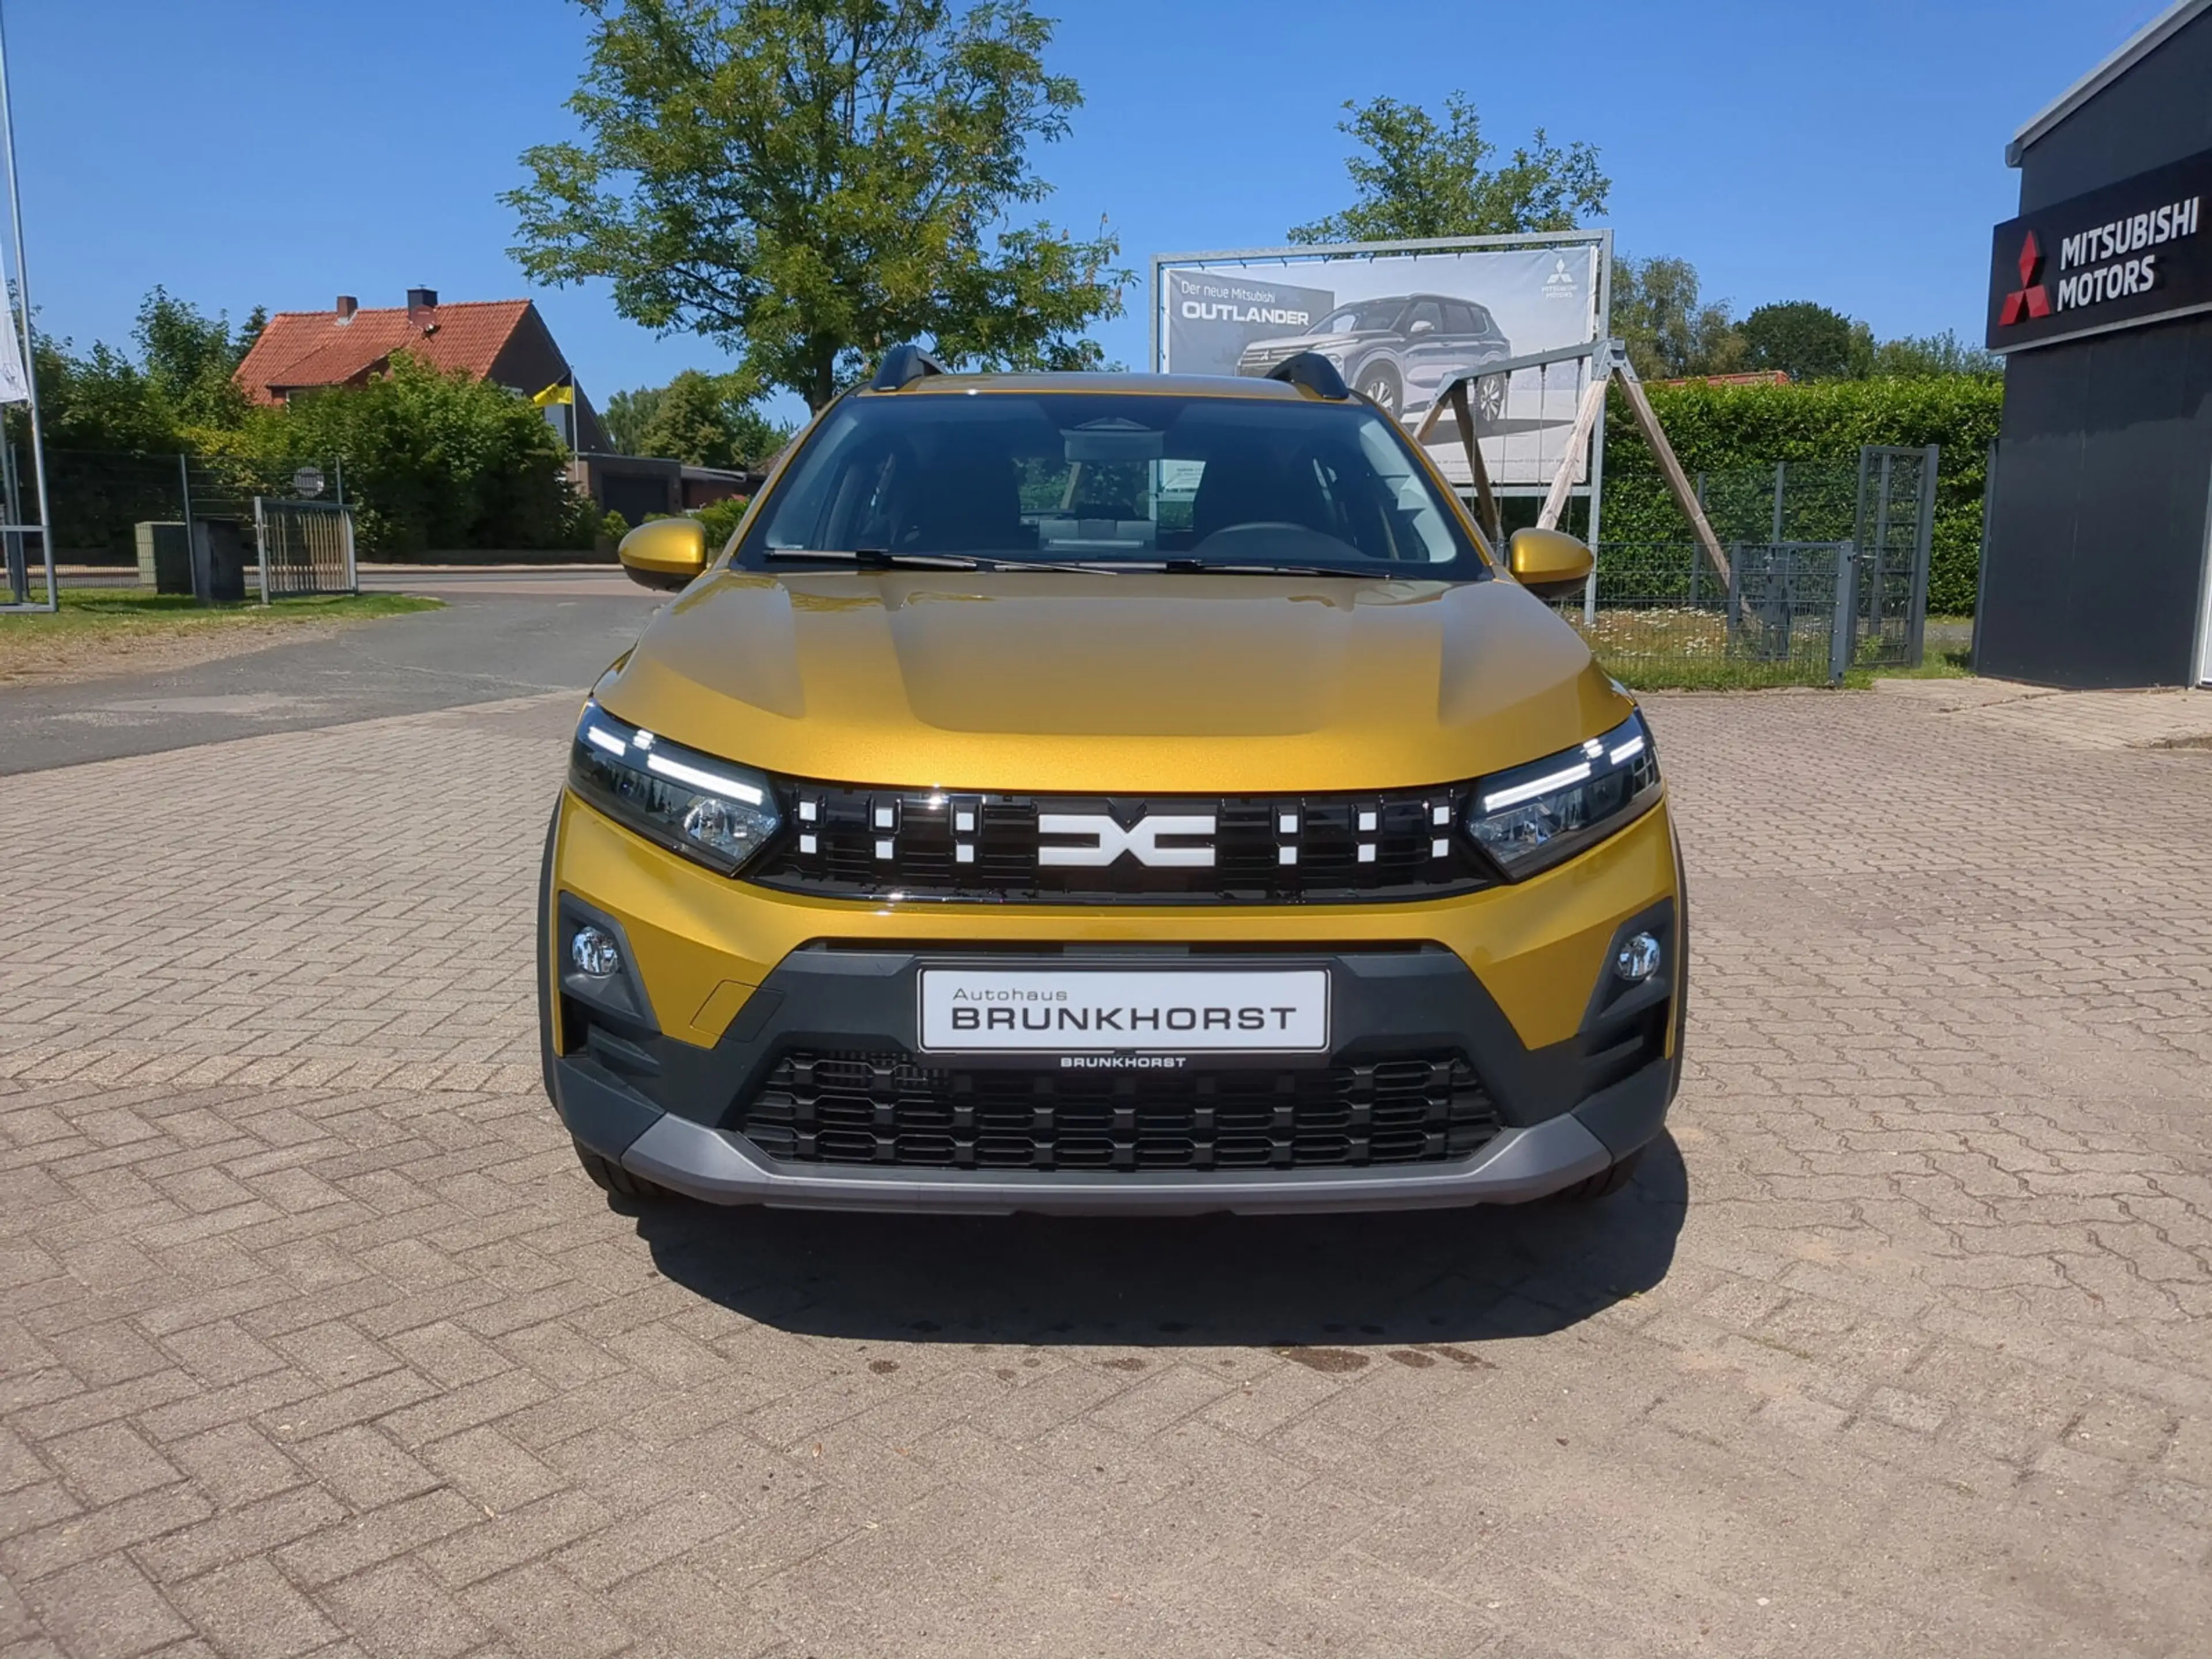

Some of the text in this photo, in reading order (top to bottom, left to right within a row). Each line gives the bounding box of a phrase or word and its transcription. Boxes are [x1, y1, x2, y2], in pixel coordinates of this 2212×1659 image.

[2060, 196, 2199, 271] MITSUBISHI
[1181, 281, 1275, 302] Der neue Mitsubishi
[2056, 254, 2156, 312] MOTORS
[1181, 301, 1309, 325] OUTLANDER
[952, 987, 1068, 1001] Autohaus
[952, 1007, 1297, 1031] BRUNKHORST
[1060, 1057, 1187, 1067] BRUNKHORST
